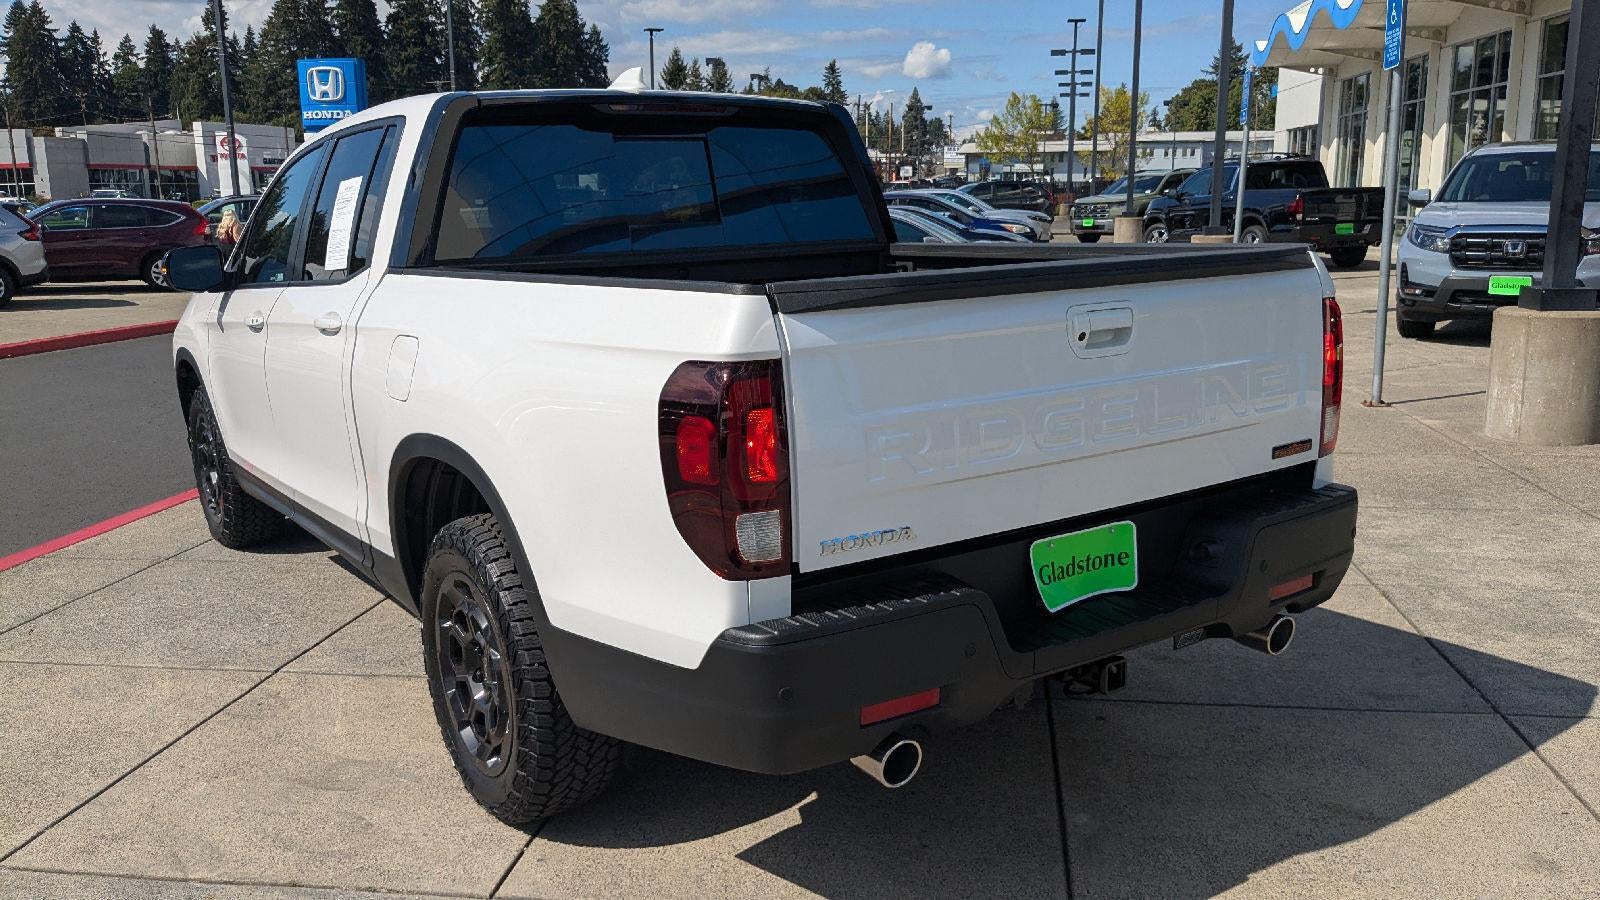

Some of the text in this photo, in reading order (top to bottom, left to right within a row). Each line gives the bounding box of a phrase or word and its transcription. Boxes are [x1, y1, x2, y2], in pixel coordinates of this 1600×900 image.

[303, 110, 352, 119] HONDA
[864, 365, 1289, 482] RIDGELINE
[820, 526, 917, 557] HONDA
[1039, 551, 1130, 586] Gladstone
